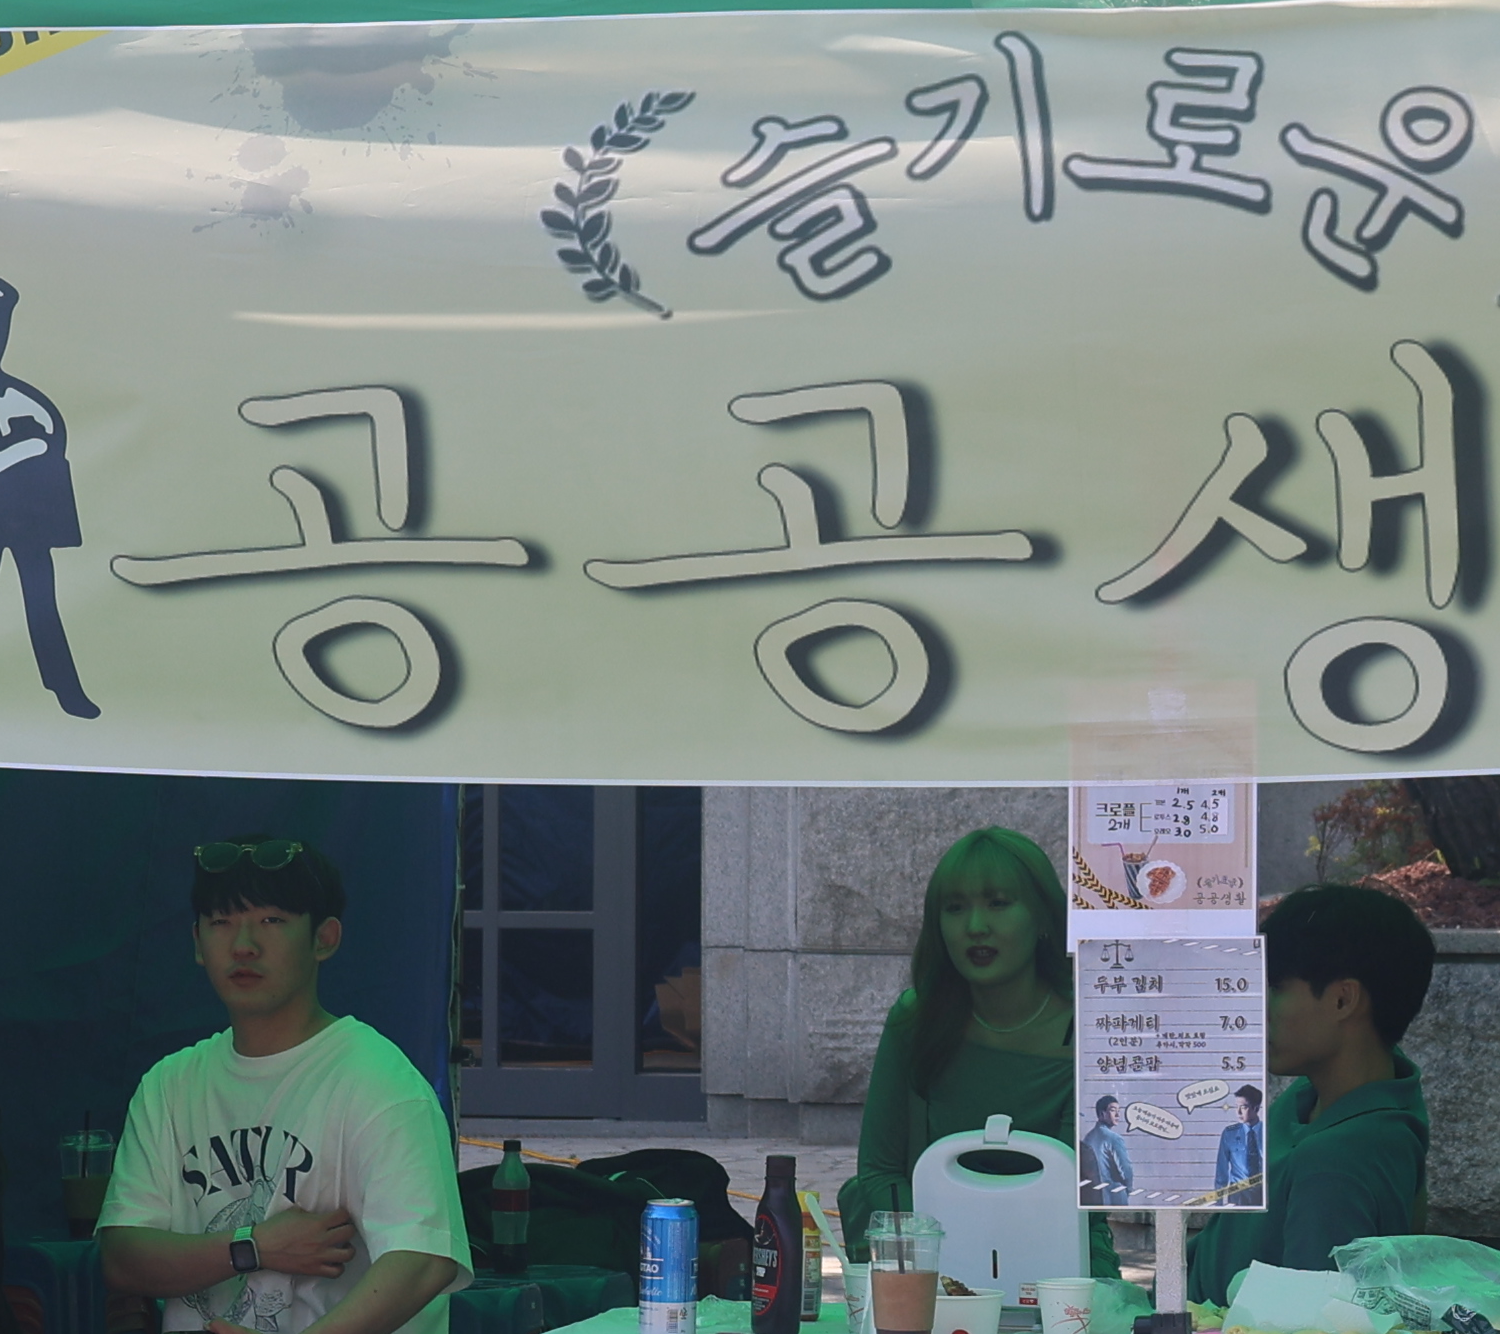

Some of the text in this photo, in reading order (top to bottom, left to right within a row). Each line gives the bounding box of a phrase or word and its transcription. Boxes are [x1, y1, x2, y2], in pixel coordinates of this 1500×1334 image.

[686, 31, 1473, 302] 슬기로운
[1096, 803, 1136, 817] 크로플
[1171, 798, 1195, 811] 2.5
[1108, 819, 1131, 831] 2개
[1094, 975, 1249, 994] 두부 김치 15.0
[1096, 1014, 1247, 1032] 짜파게티 7.0
[1108, 1037, 1142, 1048] (2인분)
[1221, 1056, 1247, 1071] 5.5
[180, 1124, 316, 1206] SATUR
